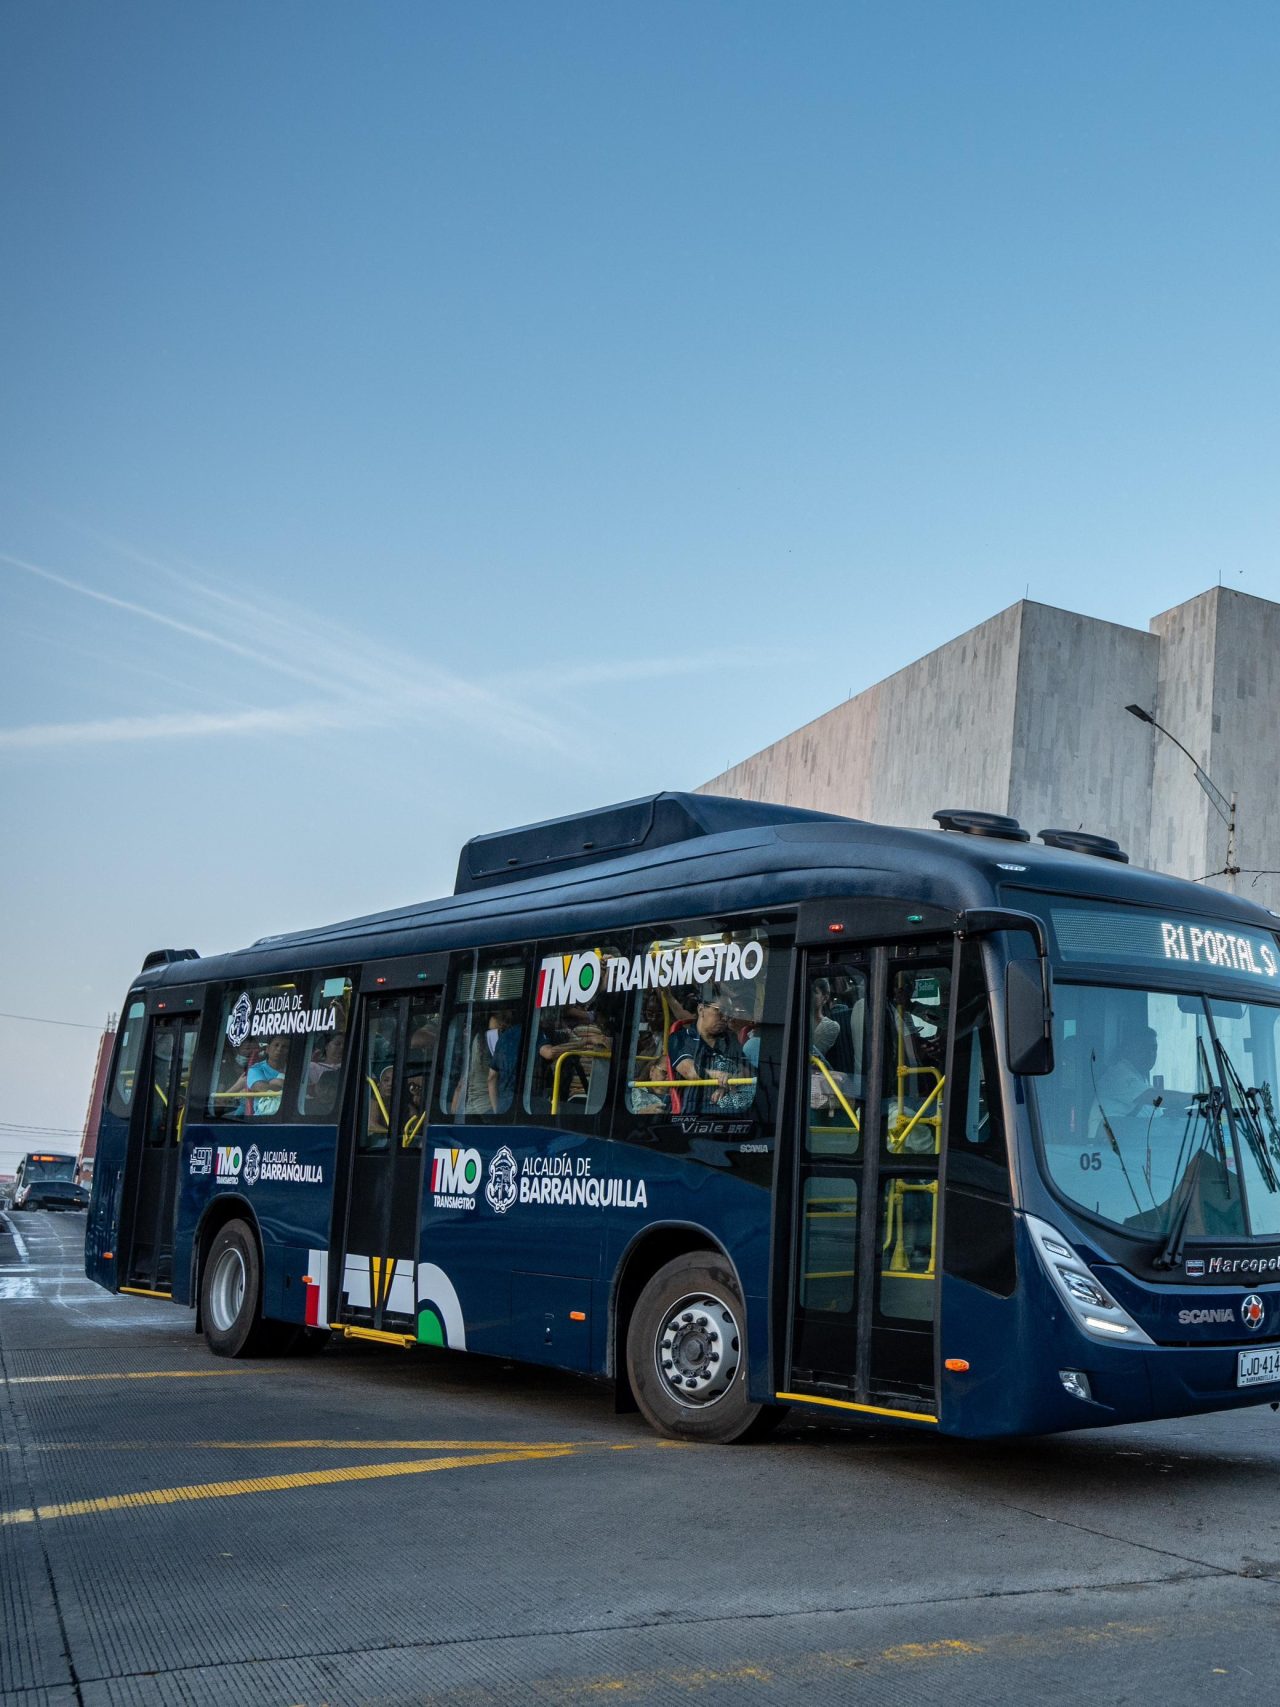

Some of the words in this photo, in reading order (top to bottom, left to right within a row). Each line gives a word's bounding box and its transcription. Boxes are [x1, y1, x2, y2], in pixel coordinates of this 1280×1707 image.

[1161, 922, 1189, 960] R1
[1190, 927, 1262, 974] PORTAL
[484, 970, 502, 1000] R1
[535, 950, 601, 1008] TMO
[255, 992, 290, 1013] ALCALDÍA
[292, 995, 303, 1010] DE
[251, 1007, 336, 1036] BARRANQUILLA
[681, 1122, 724, 1134] Viale
[214, 1146, 243, 1175] TMO
[262, 1149, 288, 1163] ALCALDÍA
[289, 1151, 298, 1164] DE
[521, 1153, 573, 1176] ALCALDÍA
[576, 1157, 592, 1177] DE
[1080, 1152, 1102, 1171] 05
[260, 1163, 323, 1183] BARRANQUILLA
[430, 1148, 482, 1195] TMO
[519, 1177, 648, 1208] BARRANQUILLA
